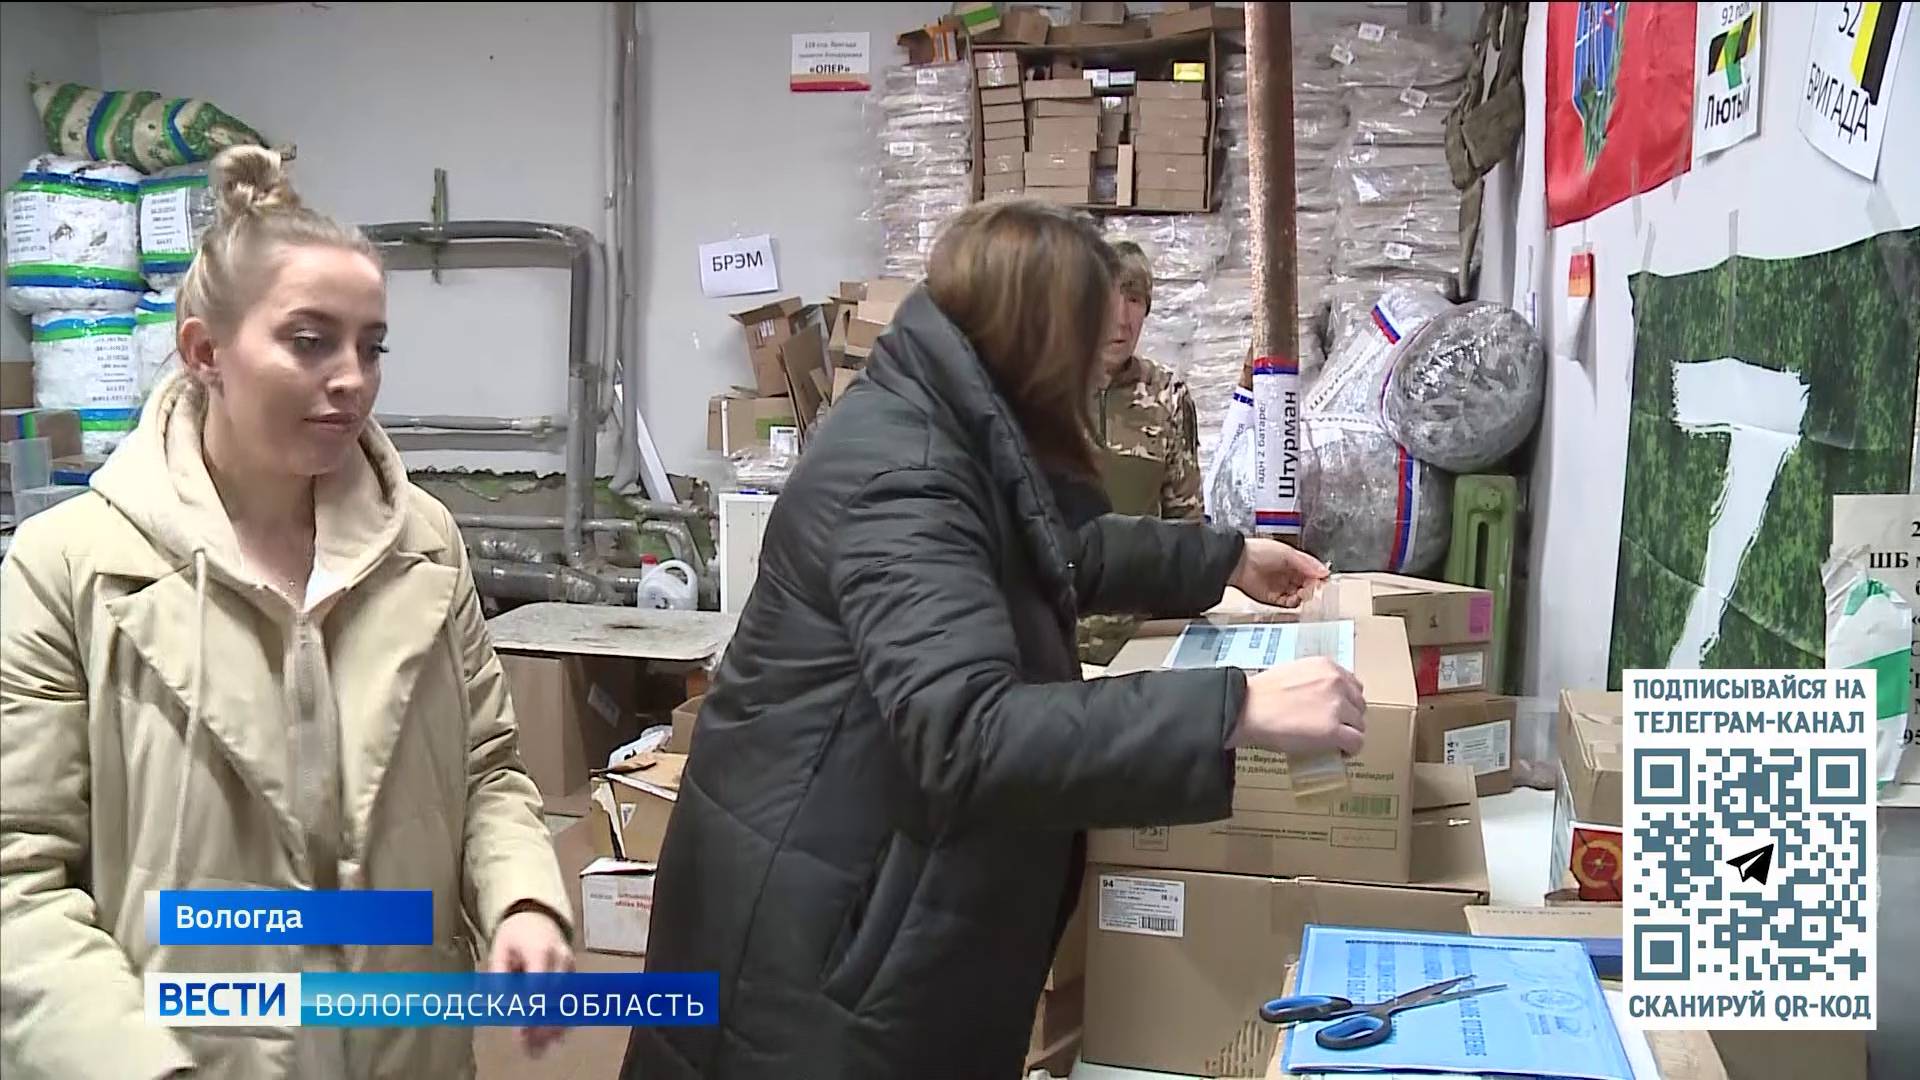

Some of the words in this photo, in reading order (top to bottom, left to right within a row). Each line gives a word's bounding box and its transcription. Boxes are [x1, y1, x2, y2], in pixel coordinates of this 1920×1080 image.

[1721, 5, 1735, 26] 92
[809, 64, 850, 75] «ОПЕР»
[1704, 76, 1752, 130] Лютый
[1807, 62, 1869, 144] БРИГАДА
[712, 250, 763, 272] БРЭМ
[1257, 402, 1268, 446] батаре
[1278, 391, 1299, 498] Штурман
[1870, 552, 1909, 569] ШБ
